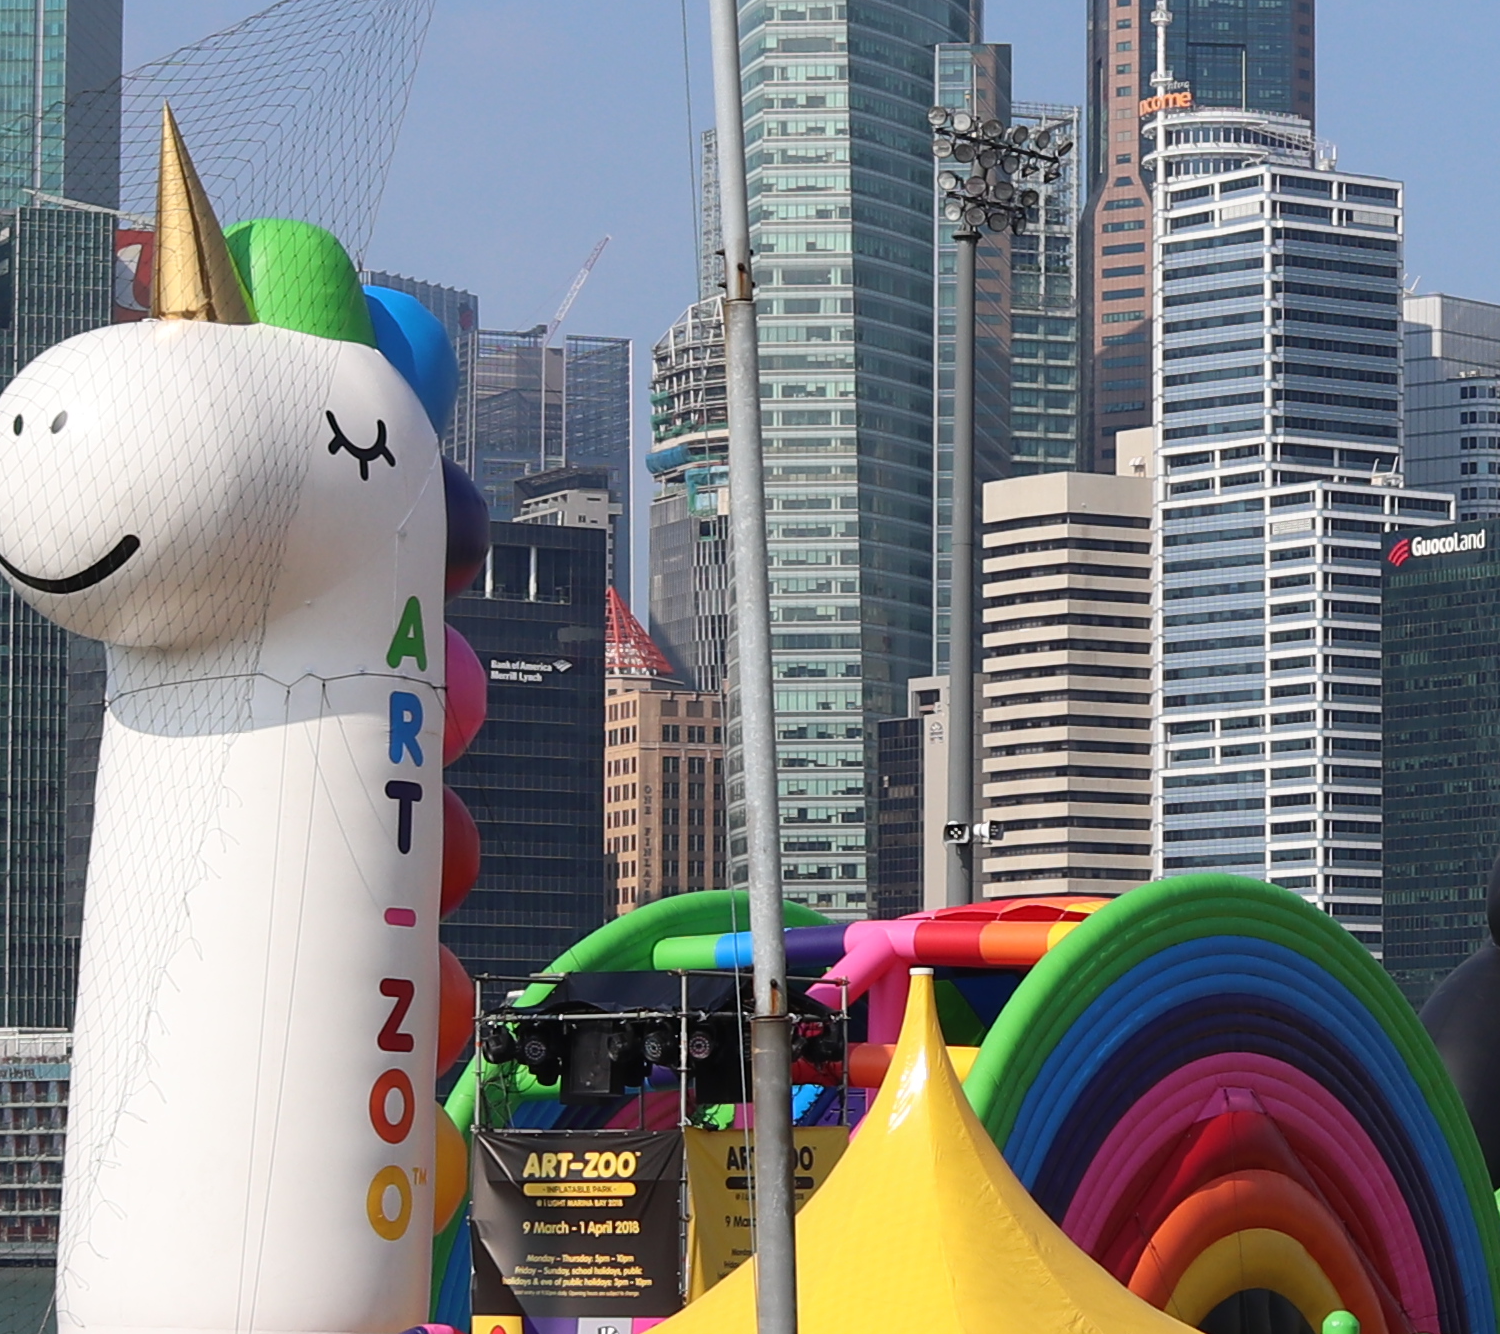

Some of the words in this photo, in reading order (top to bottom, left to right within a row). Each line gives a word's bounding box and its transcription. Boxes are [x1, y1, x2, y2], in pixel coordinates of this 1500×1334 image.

[1411, 528, 1486, 557] GuocoLand
[490, 659, 511, 669] Bank
[511, 660, 520, 670] of
[520, 661, 553, 672] America
[490, 670, 518, 681] Merrill
[518, 671, 543, 683] Lynch
[522, 1151, 637, 1179] ART-ZOO
[522, 1222, 531, 1234] 9
[533, 1221, 570, 1234] March
[579, 1221, 585, 1234] 1
[587, 1221, 613, 1237] April
[615, 1221, 640, 1234] 2018
